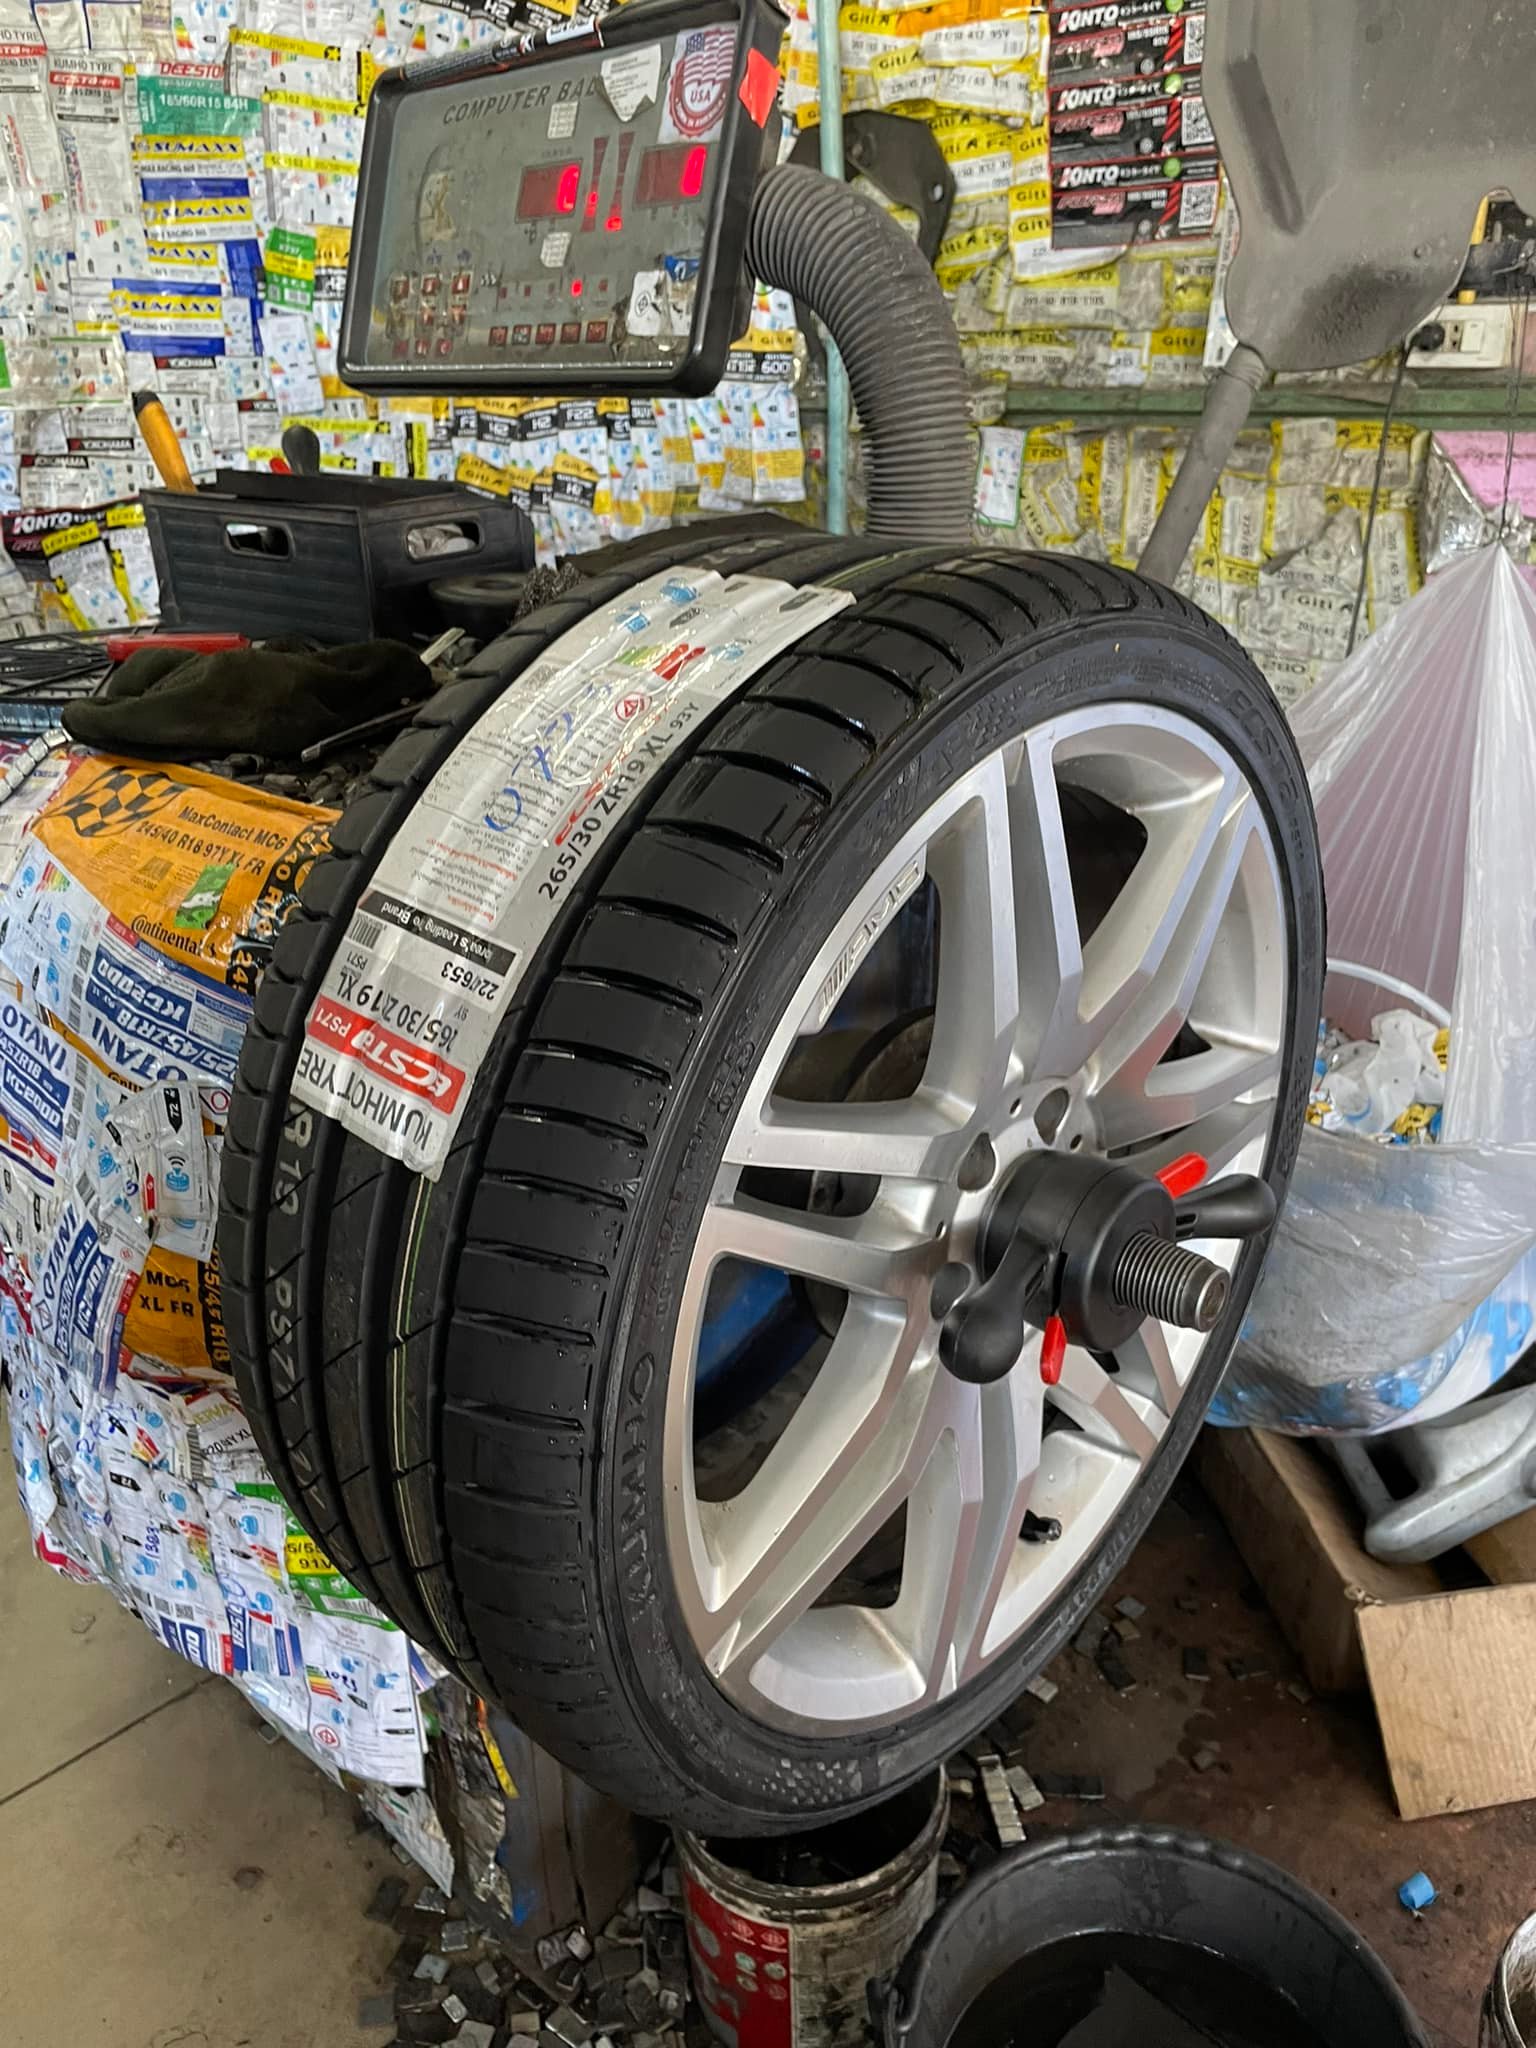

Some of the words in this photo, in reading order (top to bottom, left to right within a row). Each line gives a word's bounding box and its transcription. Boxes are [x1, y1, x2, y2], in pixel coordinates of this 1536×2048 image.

[849, 13, 874, 25] Giti
[442, 84, 550, 125] COMPUTER
[690, 89, 711, 102] USA
[538, 817, 602, 900] 265/30
[593, 753, 646, 817] ZR19
[637, 729, 672, 763] XL
[667, 700, 701, 736] 93Y
[136, 820, 176, 844] 245/40
[243, 858, 266, 876] FR
[178, 806, 251, 841] MaxContact
[252, 829, 288, 851] MC6
[380, 900, 413, 925] Brand
[345, 950, 369, 970] PS71
[96, 956, 186, 1020] KC2000
[330, 971, 360, 1002] XL
[1, 1008, 67, 1071] OTANI
[314, 1008, 352, 1037] PS71
[5, 1071, 62, 1126] KC2000
[350, 1079, 434, 1152] KUMHO
[138, 1293, 167, 1312] XL
[169, 1297, 195, 1317] FR
